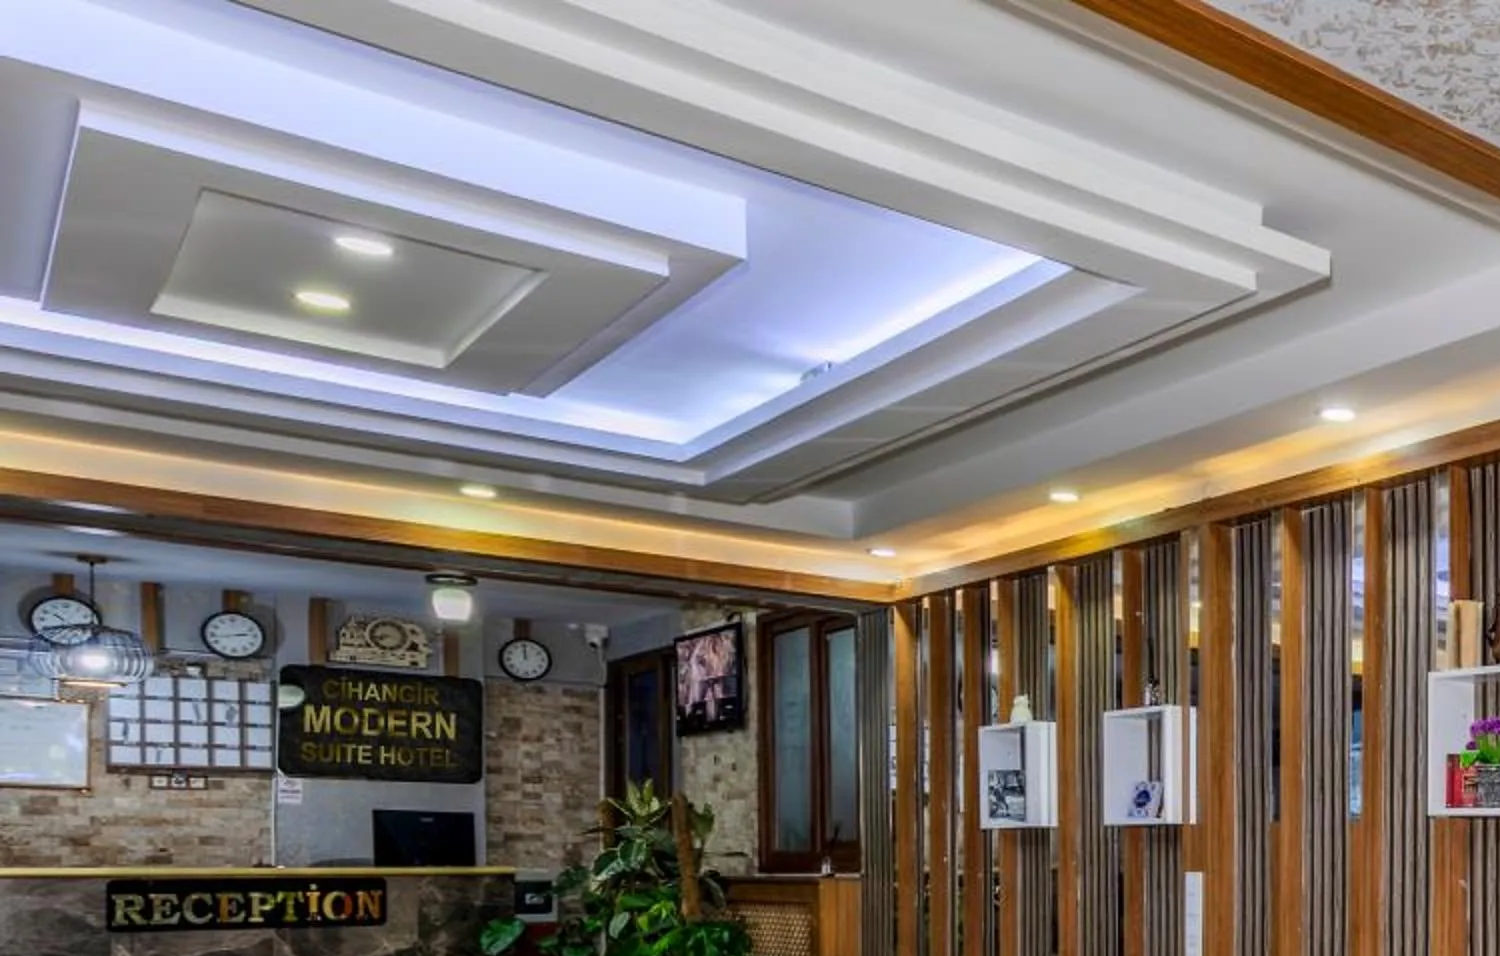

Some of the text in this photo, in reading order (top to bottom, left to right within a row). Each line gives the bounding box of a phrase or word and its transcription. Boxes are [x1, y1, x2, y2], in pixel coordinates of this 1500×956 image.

[303, 704, 457, 740] MODERN
[301, 740, 458, 768] SUITE HOTEL
